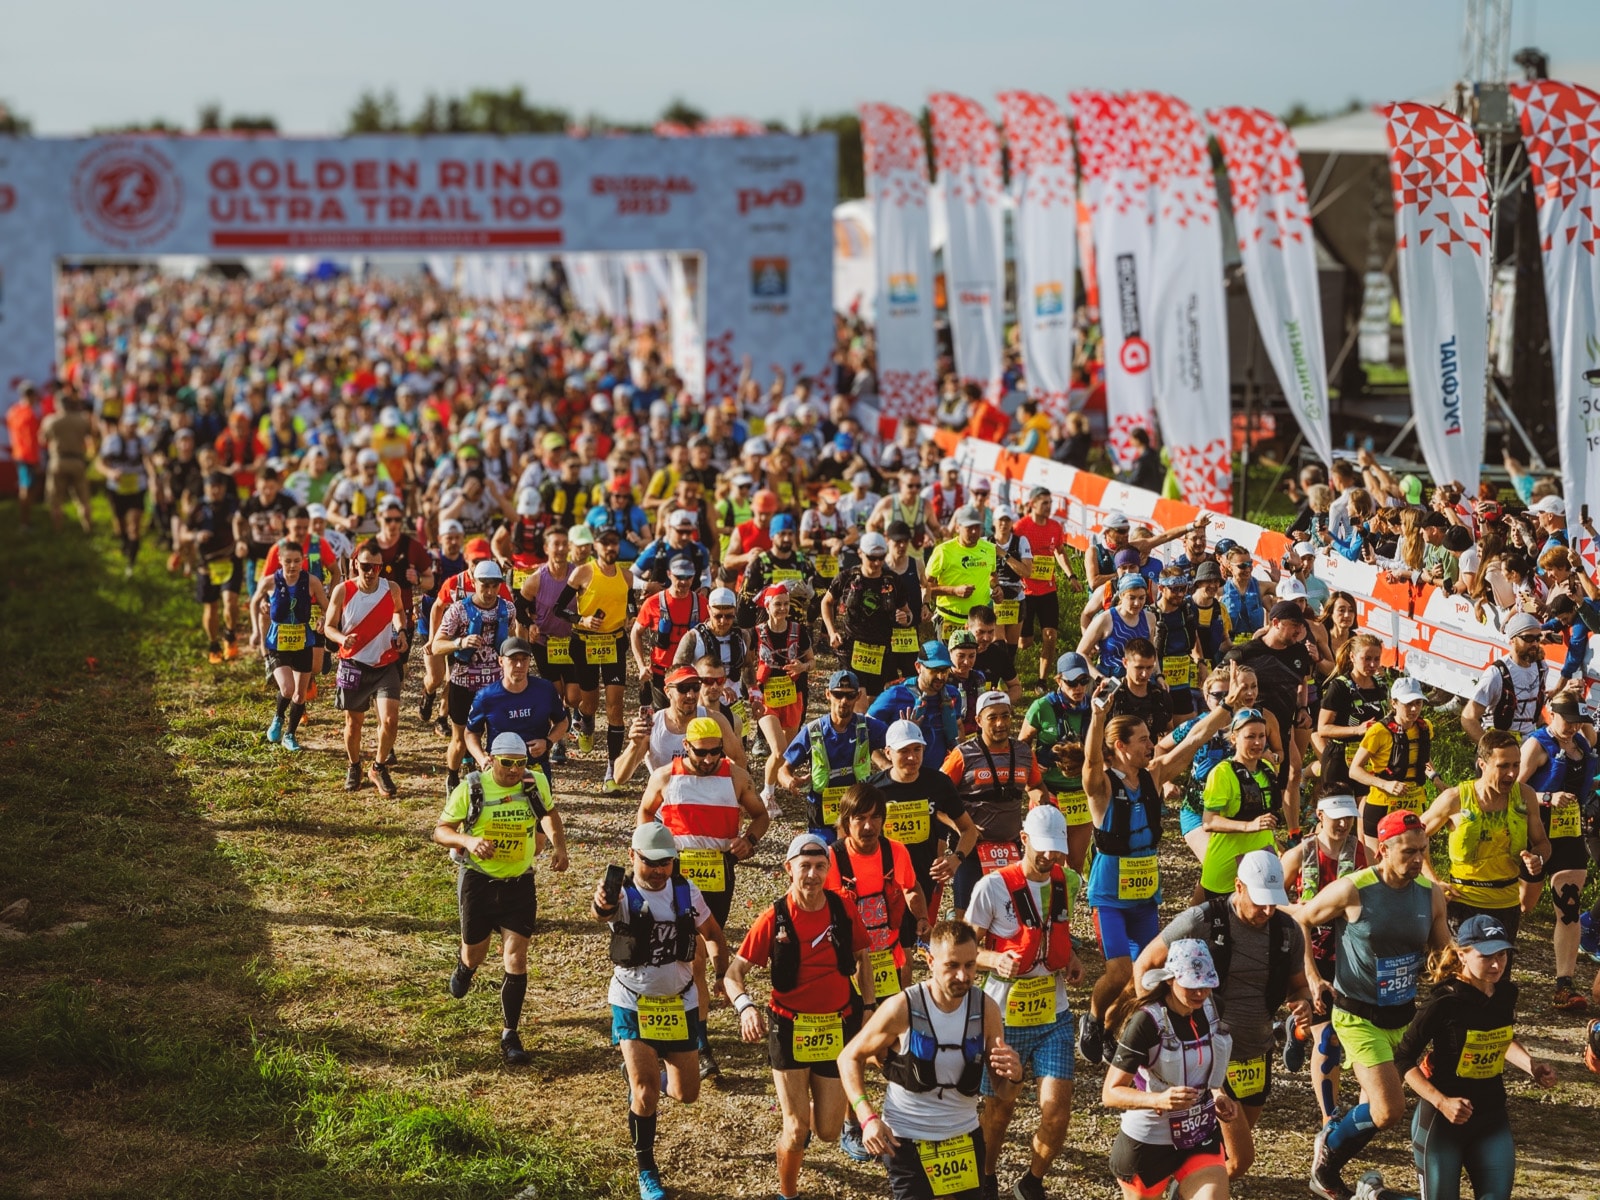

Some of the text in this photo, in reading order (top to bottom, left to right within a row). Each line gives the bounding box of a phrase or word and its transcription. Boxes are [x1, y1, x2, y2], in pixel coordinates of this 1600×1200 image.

[208, 158, 561, 191] GOLDEN RING
[208, 194, 563, 223] ULTRA TRAIL 100
[553, 648, 568, 656] 398
[857, 654, 877, 665] 3366
[475, 675, 495, 683] 5191
[771, 688, 791, 699] 3592
[1067, 803, 1088, 815] 3972
[893, 820, 921, 832] 3431
[493, 839, 519, 850] 3477
[990, 848, 1009, 858] 089
[688, 868, 717, 879] 3444
[1128, 876, 1153, 888] 3006
[1387, 974, 1413, 991] 2520
[1017, 997, 1047, 1012] 3174
[647, 1014, 678, 1026] 3925
[804, 1033, 834, 1047] 3875
[1236, 1067, 1260, 1082] 3701
[1181, 1113, 1209, 1132] 5502
[934, 1158, 968, 1178] 3604
